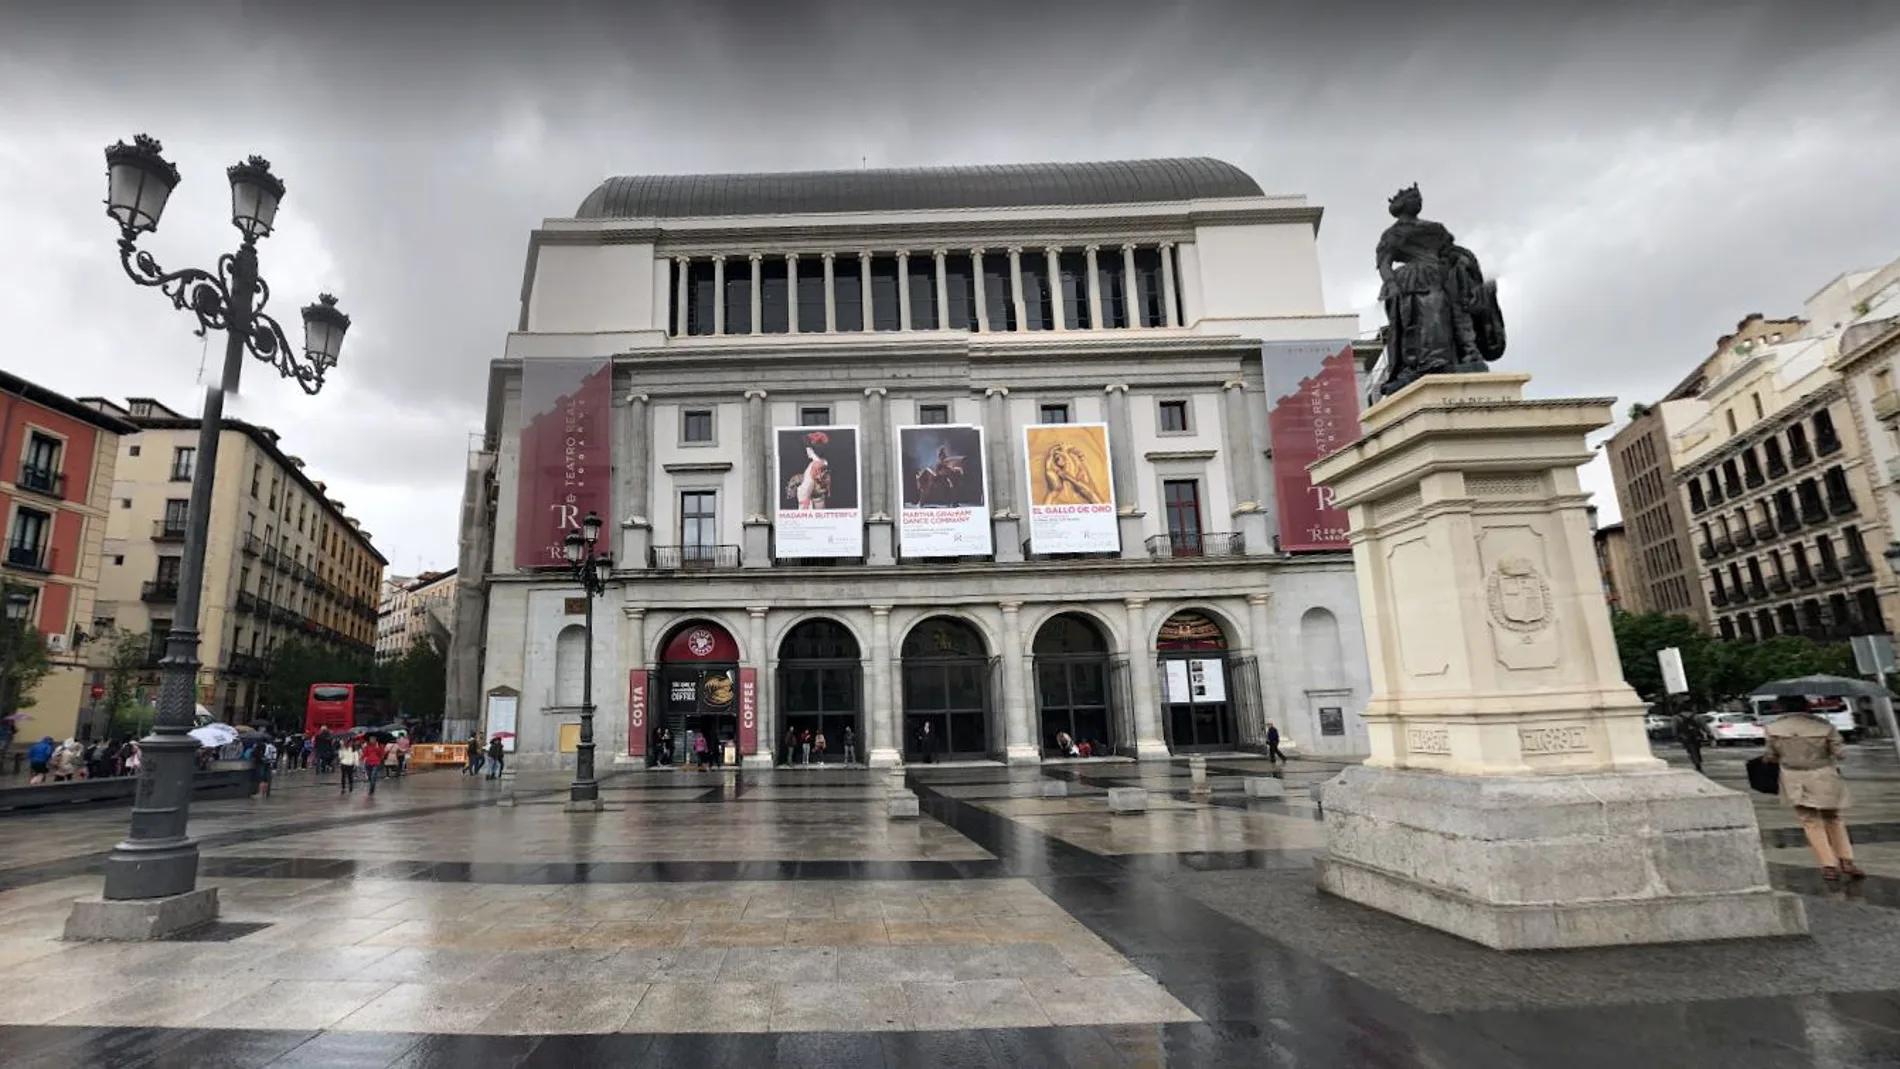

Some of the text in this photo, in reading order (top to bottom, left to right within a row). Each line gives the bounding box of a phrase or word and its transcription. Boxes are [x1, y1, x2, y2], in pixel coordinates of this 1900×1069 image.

[1311, 382, 1323, 414] REAL
[565, 400, 576, 487] TEATRO REAL
[779, 511, 858, 520] MADAMA BUTTERFLY
[936, 509, 972, 518] GRAHAM
[1091, 505, 1112, 513] ORO
[633, 686, 644, 727] COSTA
[744, 682, 753, 729] COFFEE
